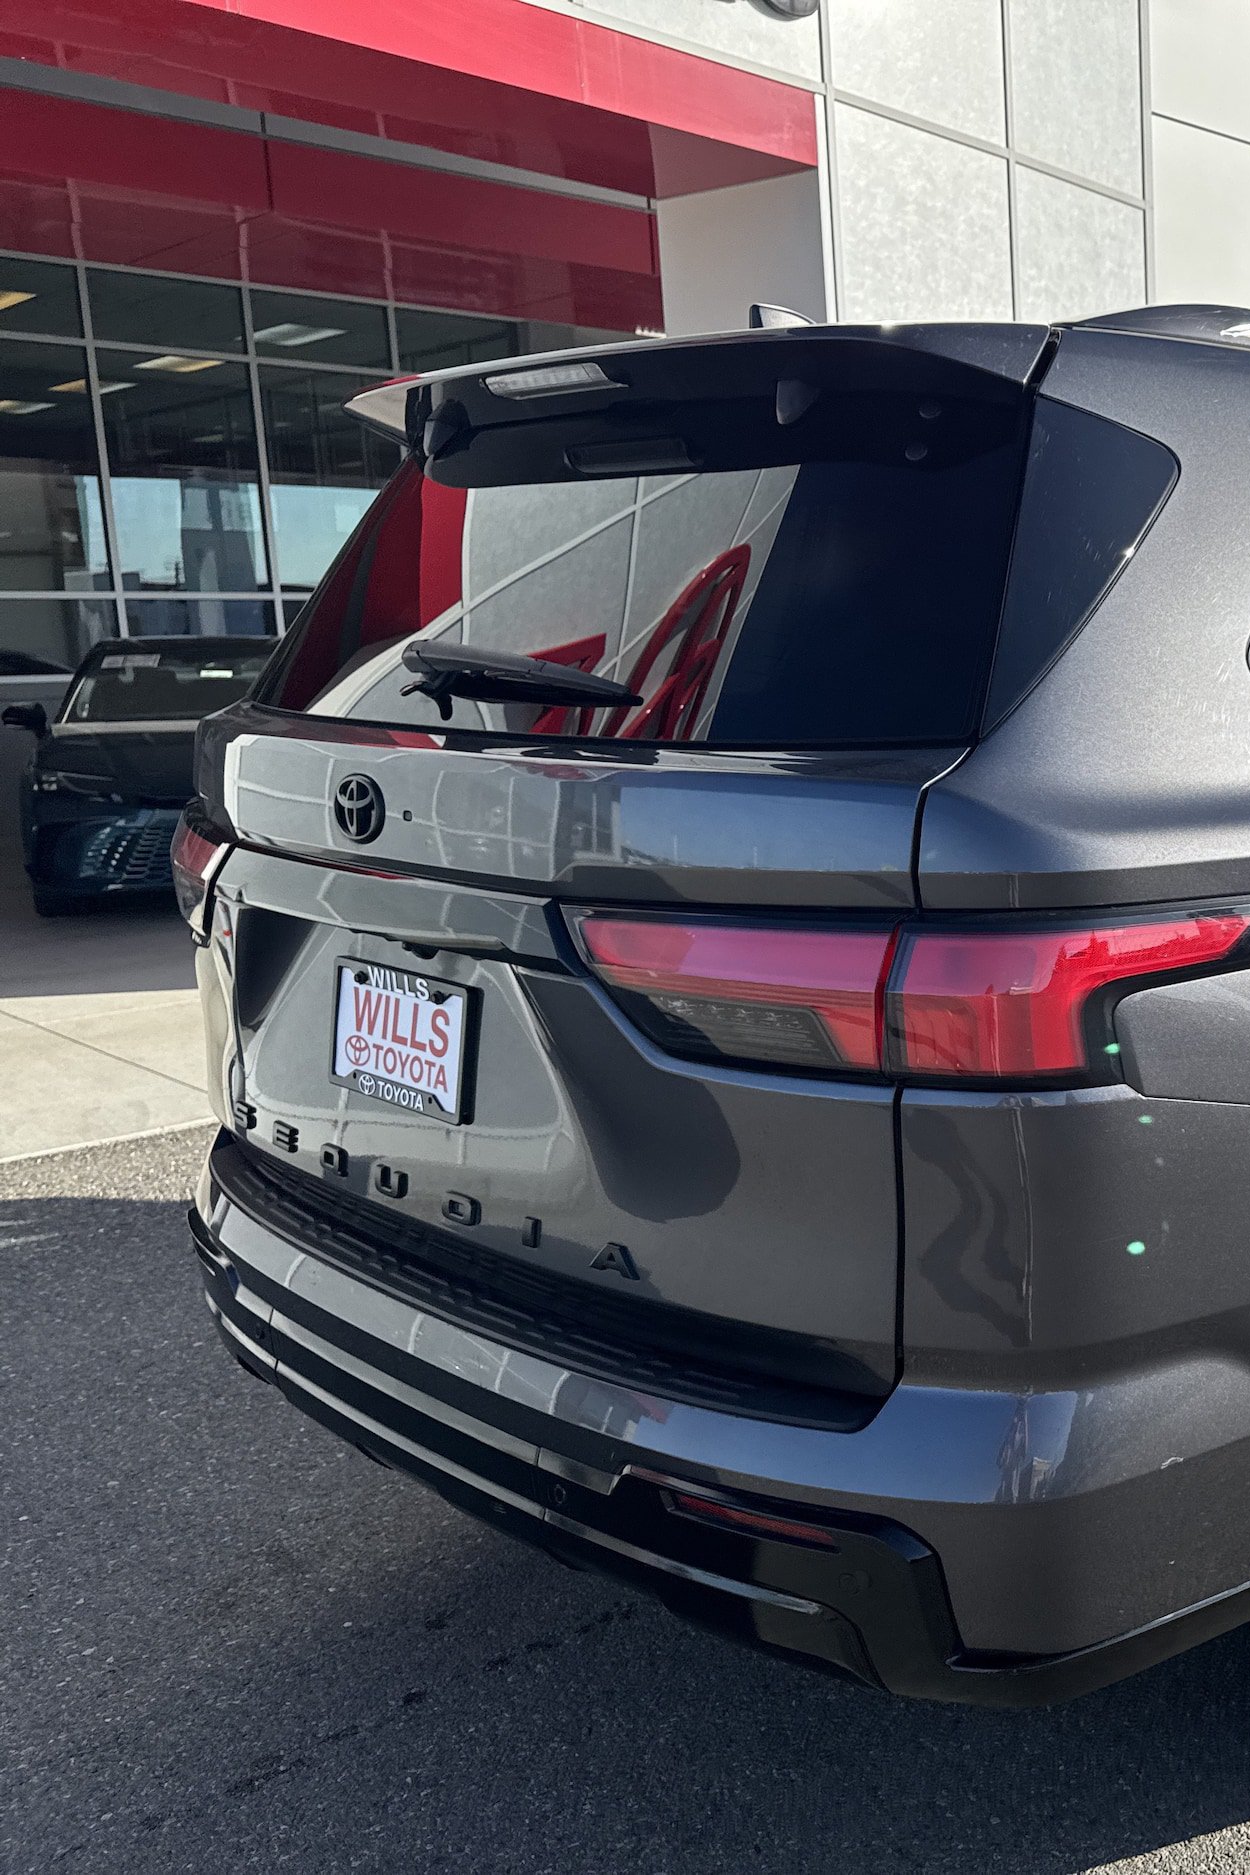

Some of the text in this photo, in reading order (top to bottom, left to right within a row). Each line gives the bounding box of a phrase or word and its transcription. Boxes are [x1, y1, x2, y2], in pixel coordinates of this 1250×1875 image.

[367, 965, 429, 1001] WILLS
[354, 986, 450, 1058] WILLS
[372, 1043, 448, 1093] TOYOTA
[377, 1081, 424, 1111] TOYOTA
[233, 1100, 640, 1281] SEQUOIA
